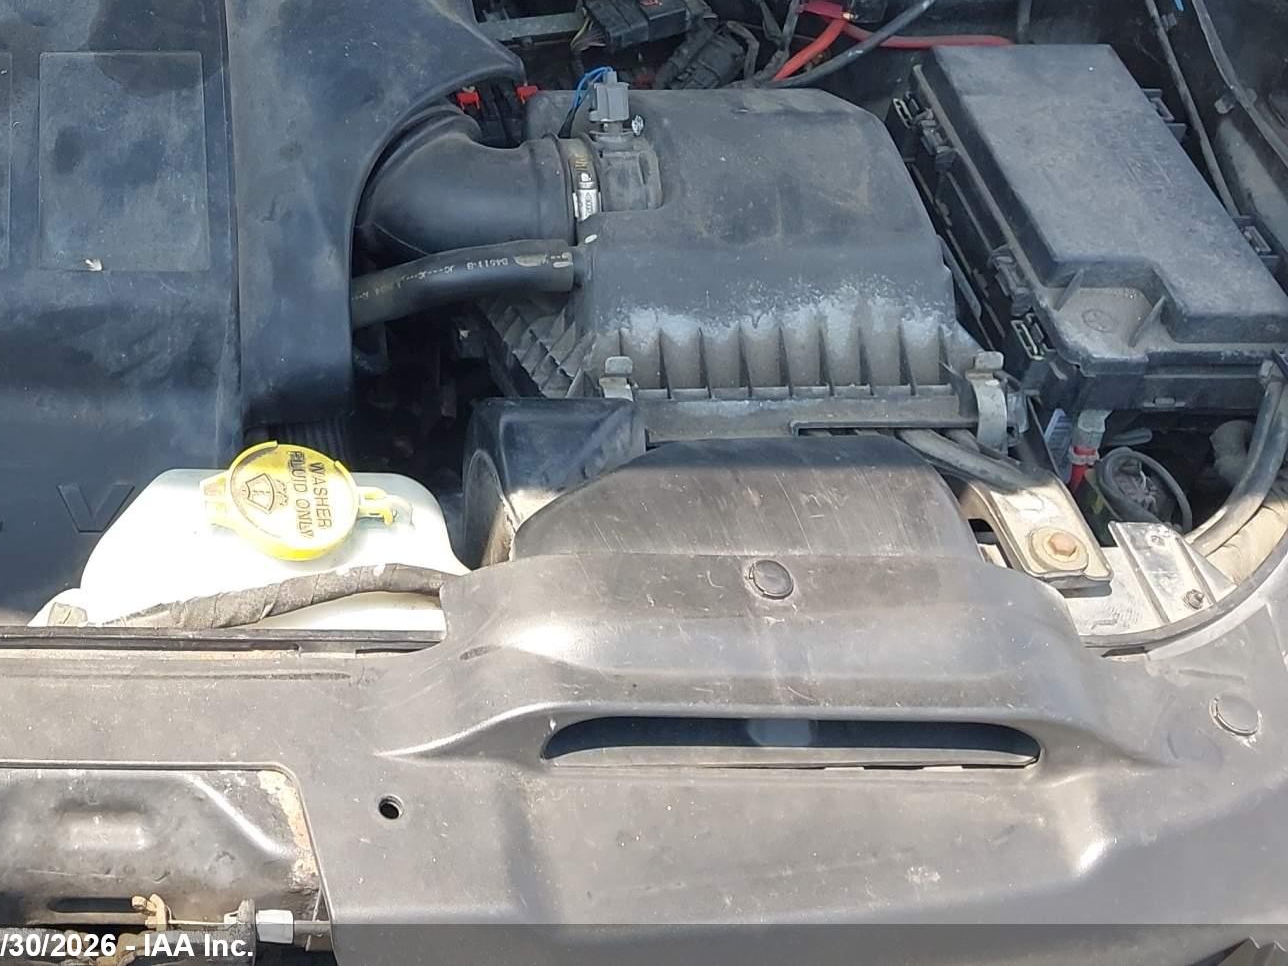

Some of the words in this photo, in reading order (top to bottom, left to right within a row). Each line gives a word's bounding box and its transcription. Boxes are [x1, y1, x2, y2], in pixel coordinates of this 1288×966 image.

[288, 450, 308, 493] FLUID
[310, 461, 333, 529] WASHER
[295, 499, 314, 538] ONLY
